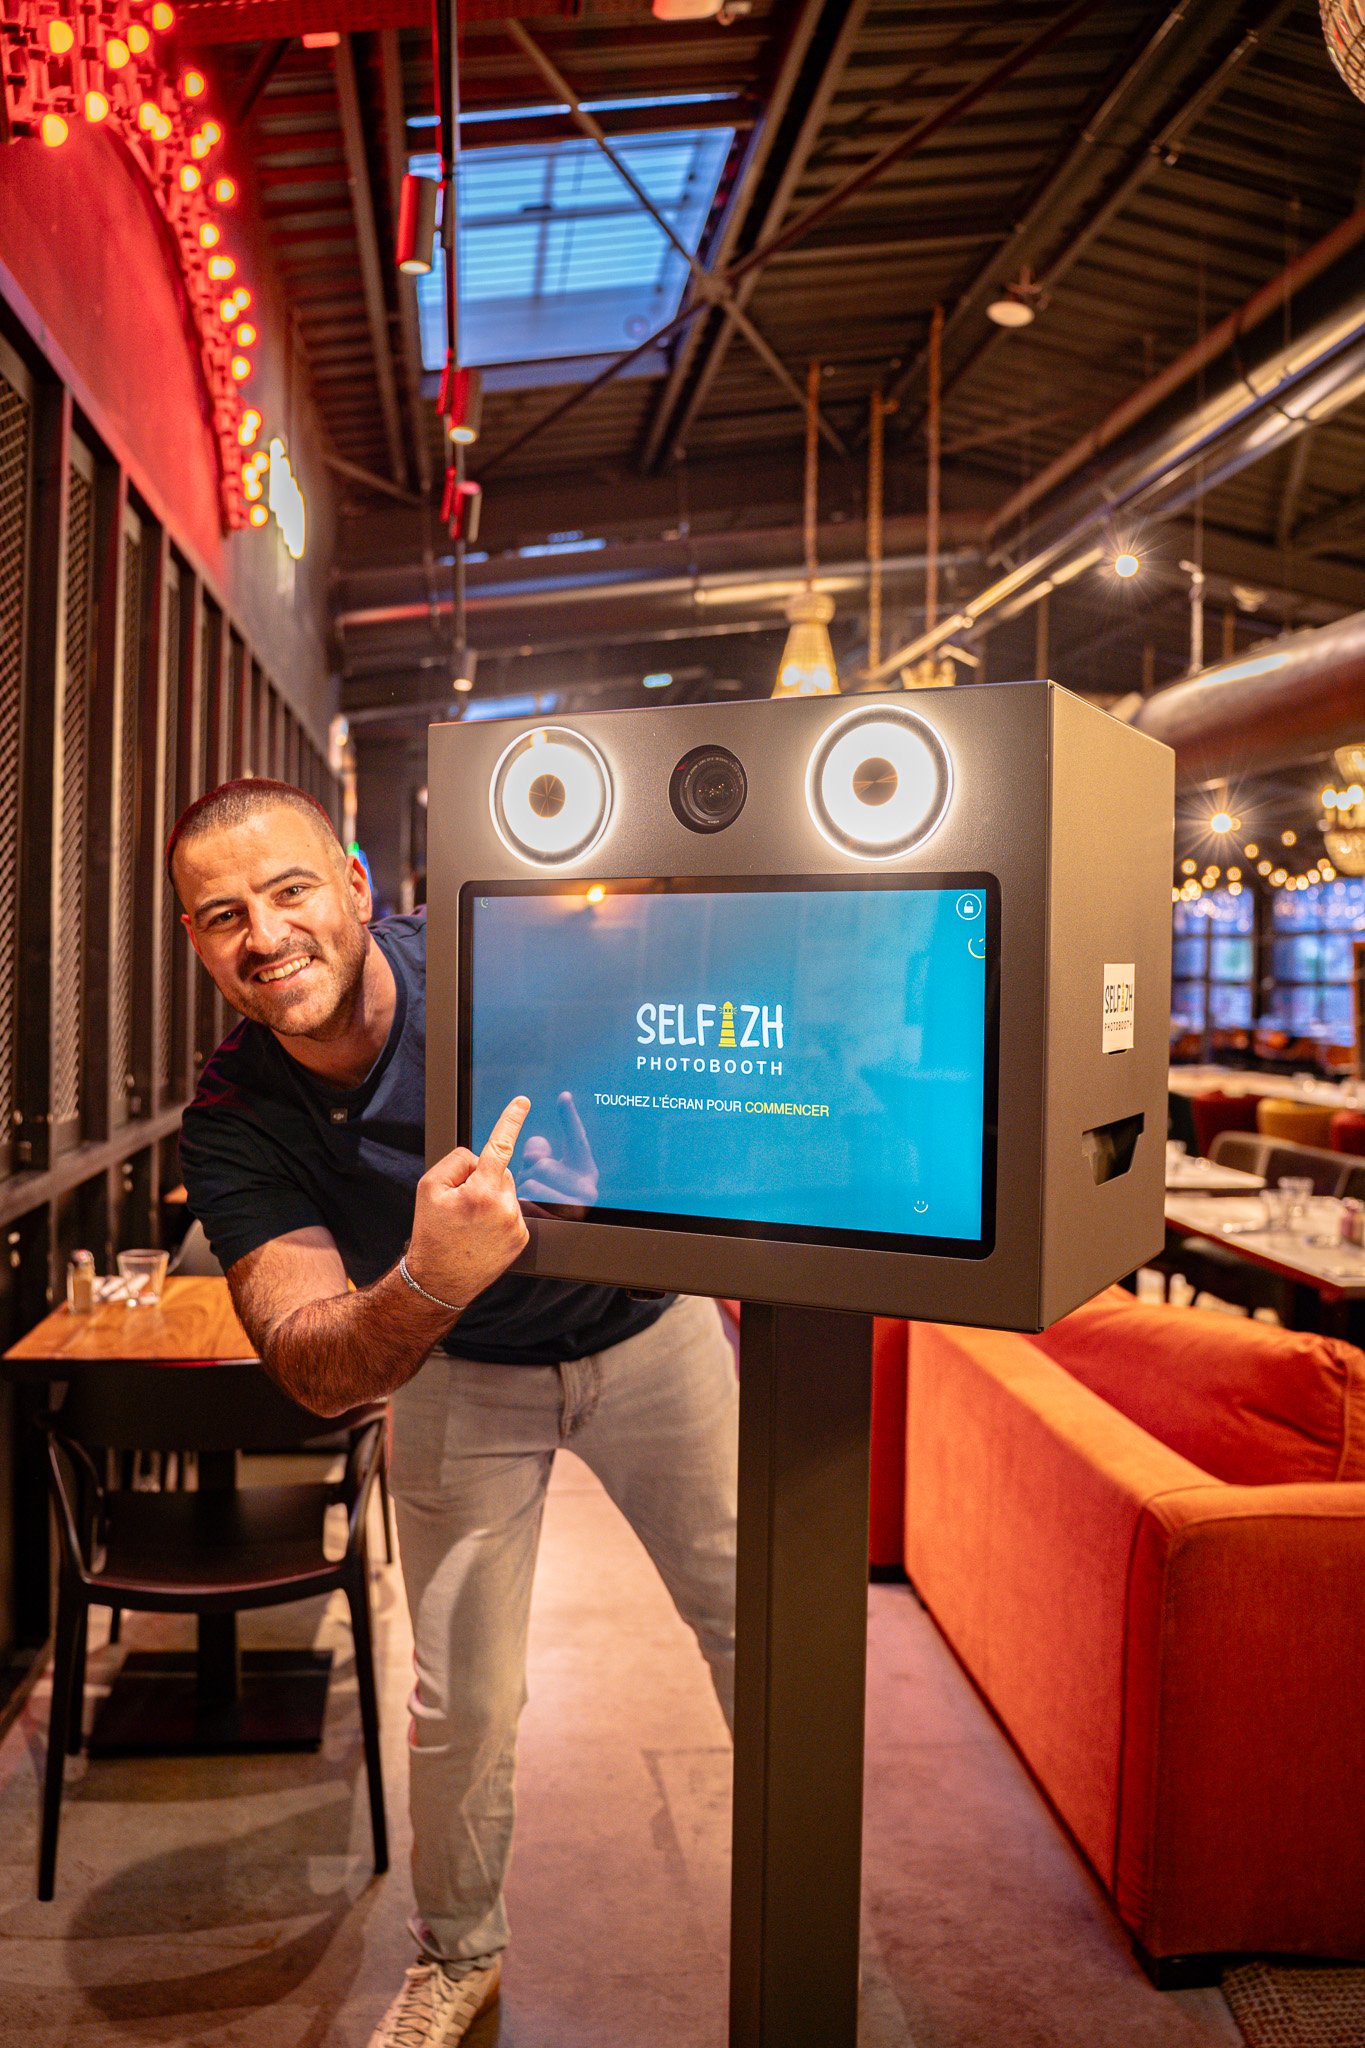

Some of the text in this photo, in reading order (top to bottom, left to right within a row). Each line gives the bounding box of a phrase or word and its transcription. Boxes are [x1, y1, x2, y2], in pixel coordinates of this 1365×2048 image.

[636, 1056, 783, 1076] PHOTOBOOTH
[594, 1093, 650, 1108] TOUCHEZ
[706, 1101, 742, 1113] POUR
[744, 1101, 830, 1117] COMMENCER
